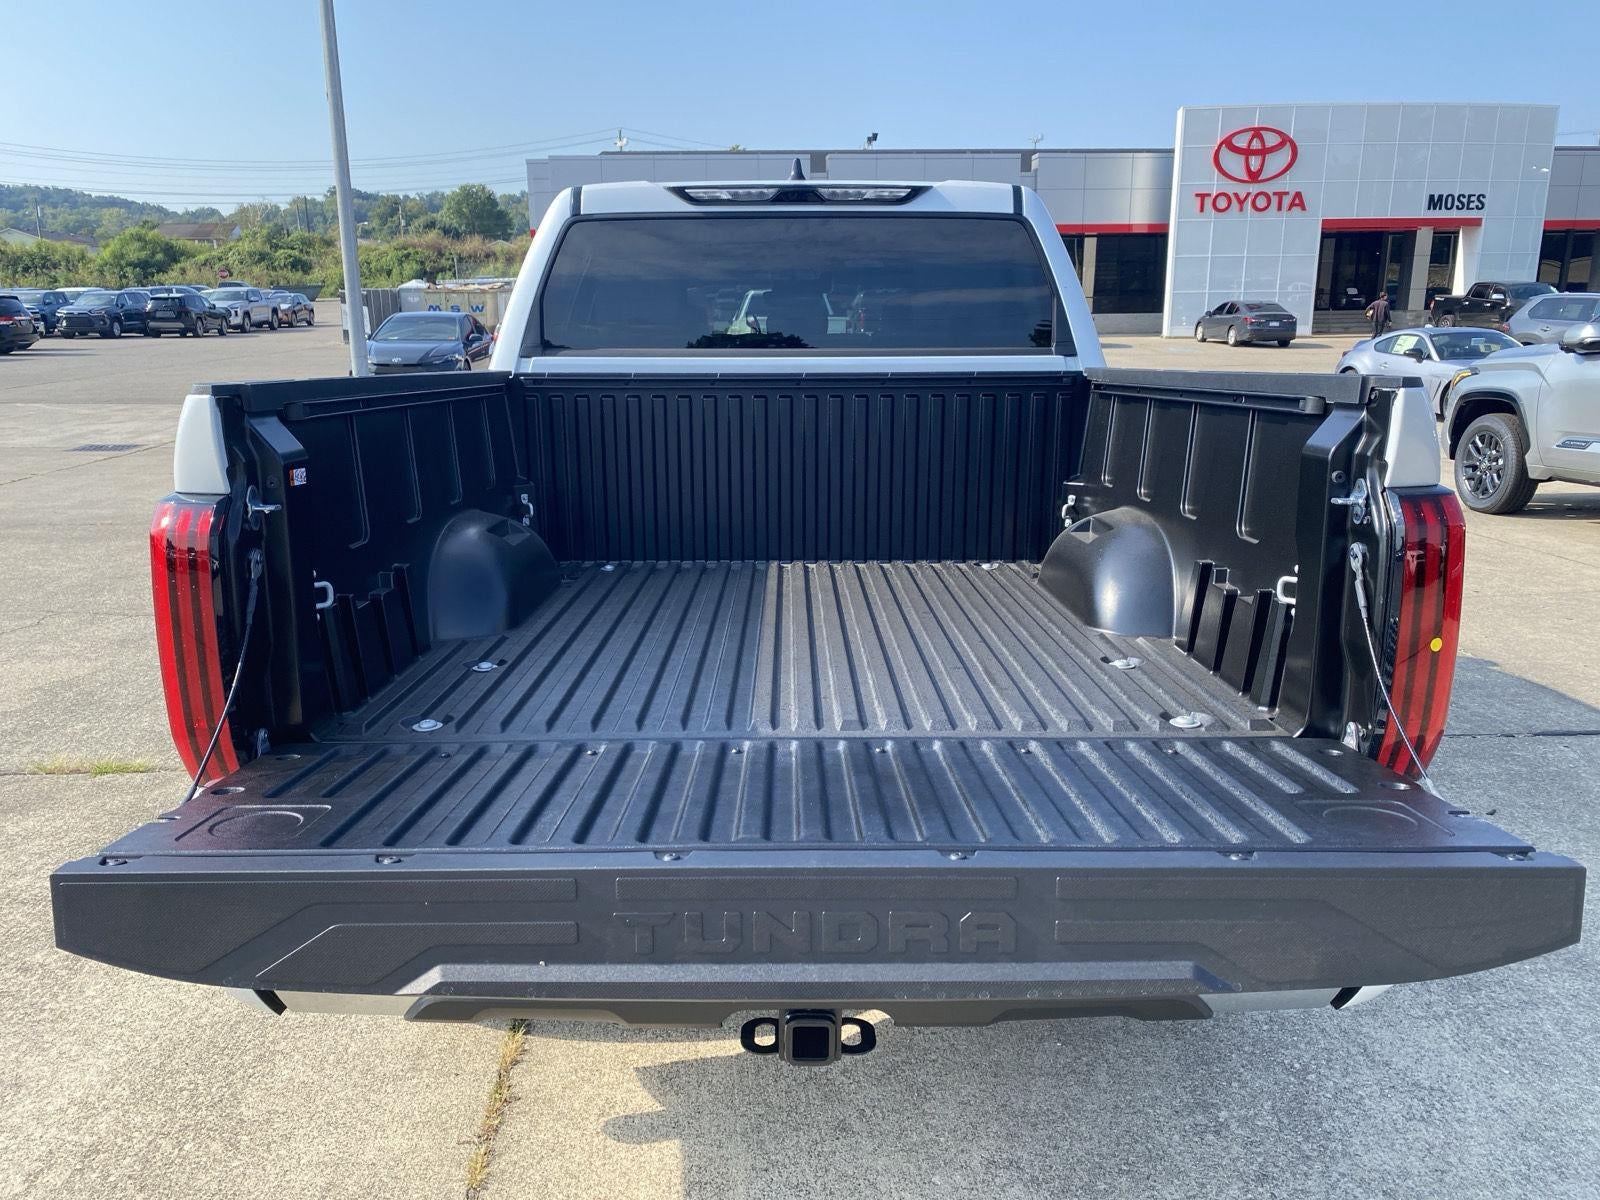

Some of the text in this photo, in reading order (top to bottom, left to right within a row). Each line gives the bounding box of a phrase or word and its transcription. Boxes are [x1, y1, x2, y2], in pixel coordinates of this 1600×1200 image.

[1194, 191, 1307, 213] TOYOTA
[1427, 193, 1487, 211] MOSES
[612, 910, 1018, 955] TUNDRA
